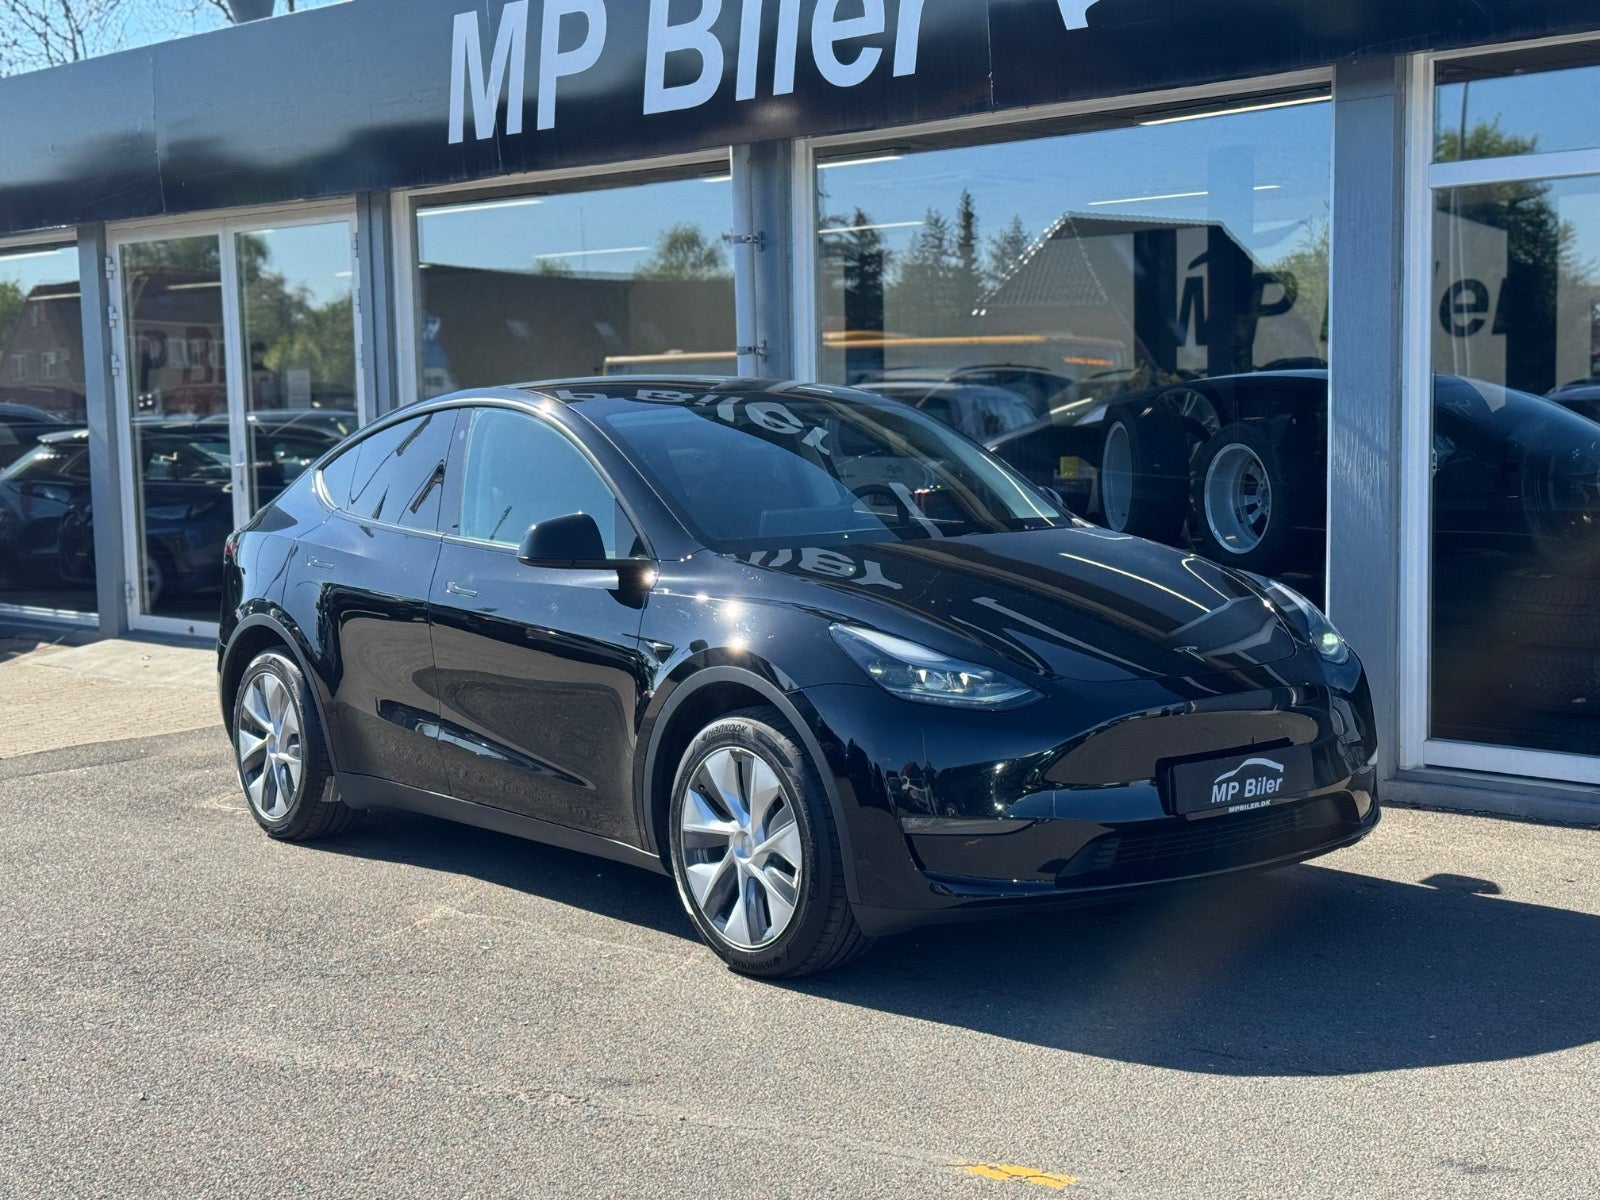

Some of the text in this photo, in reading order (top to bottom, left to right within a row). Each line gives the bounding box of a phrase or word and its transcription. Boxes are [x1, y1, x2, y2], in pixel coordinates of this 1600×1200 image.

[448, 0, 608, 145] MP
[1211, 776, 1283, 804] MP Biler
[1228, 799, 1272, 814] MPBILER.DK
